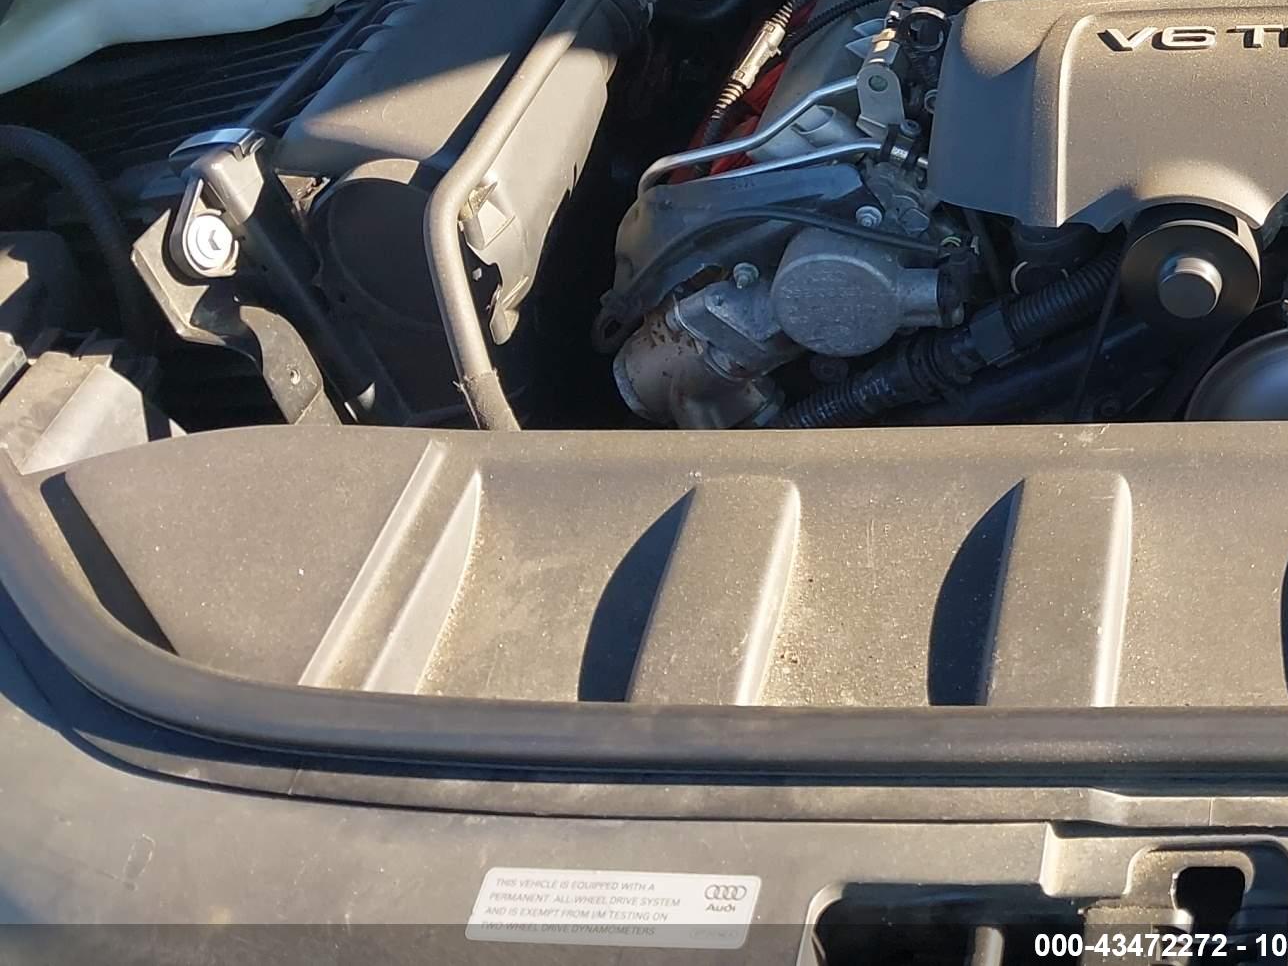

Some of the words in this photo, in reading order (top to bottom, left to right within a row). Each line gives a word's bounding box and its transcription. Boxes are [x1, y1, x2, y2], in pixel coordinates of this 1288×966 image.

[1097, 26, 1217, 52] V6
[496, 878, 517, 887] THIS
[520, 879, 558, 889] VEHICLE
[559, 880, 569, 889] IS
[571, 880, 619, 890] EQUIPPED
[620, 882, 646, 891] WITH
[489, 892, 550, 903] PERMANENT
[609, 896, 638, 906] DRIVE
[640, 897, 681, 907] SYSTEM
[485, 906, 507, 915] AND
[509, 907, 518, 916] IS
[520, 907, 560, 918] EXEMPT
[561, 909, 590, 919] FROM
[609, 911, 651, 921] TESTING
[652, 912, 669, 922] ON
[705, 904, 736, 912] Audi
[541, 924, 571, 934] DRIVE
[571, 924, 655, 936] DYNAMOMETERS
